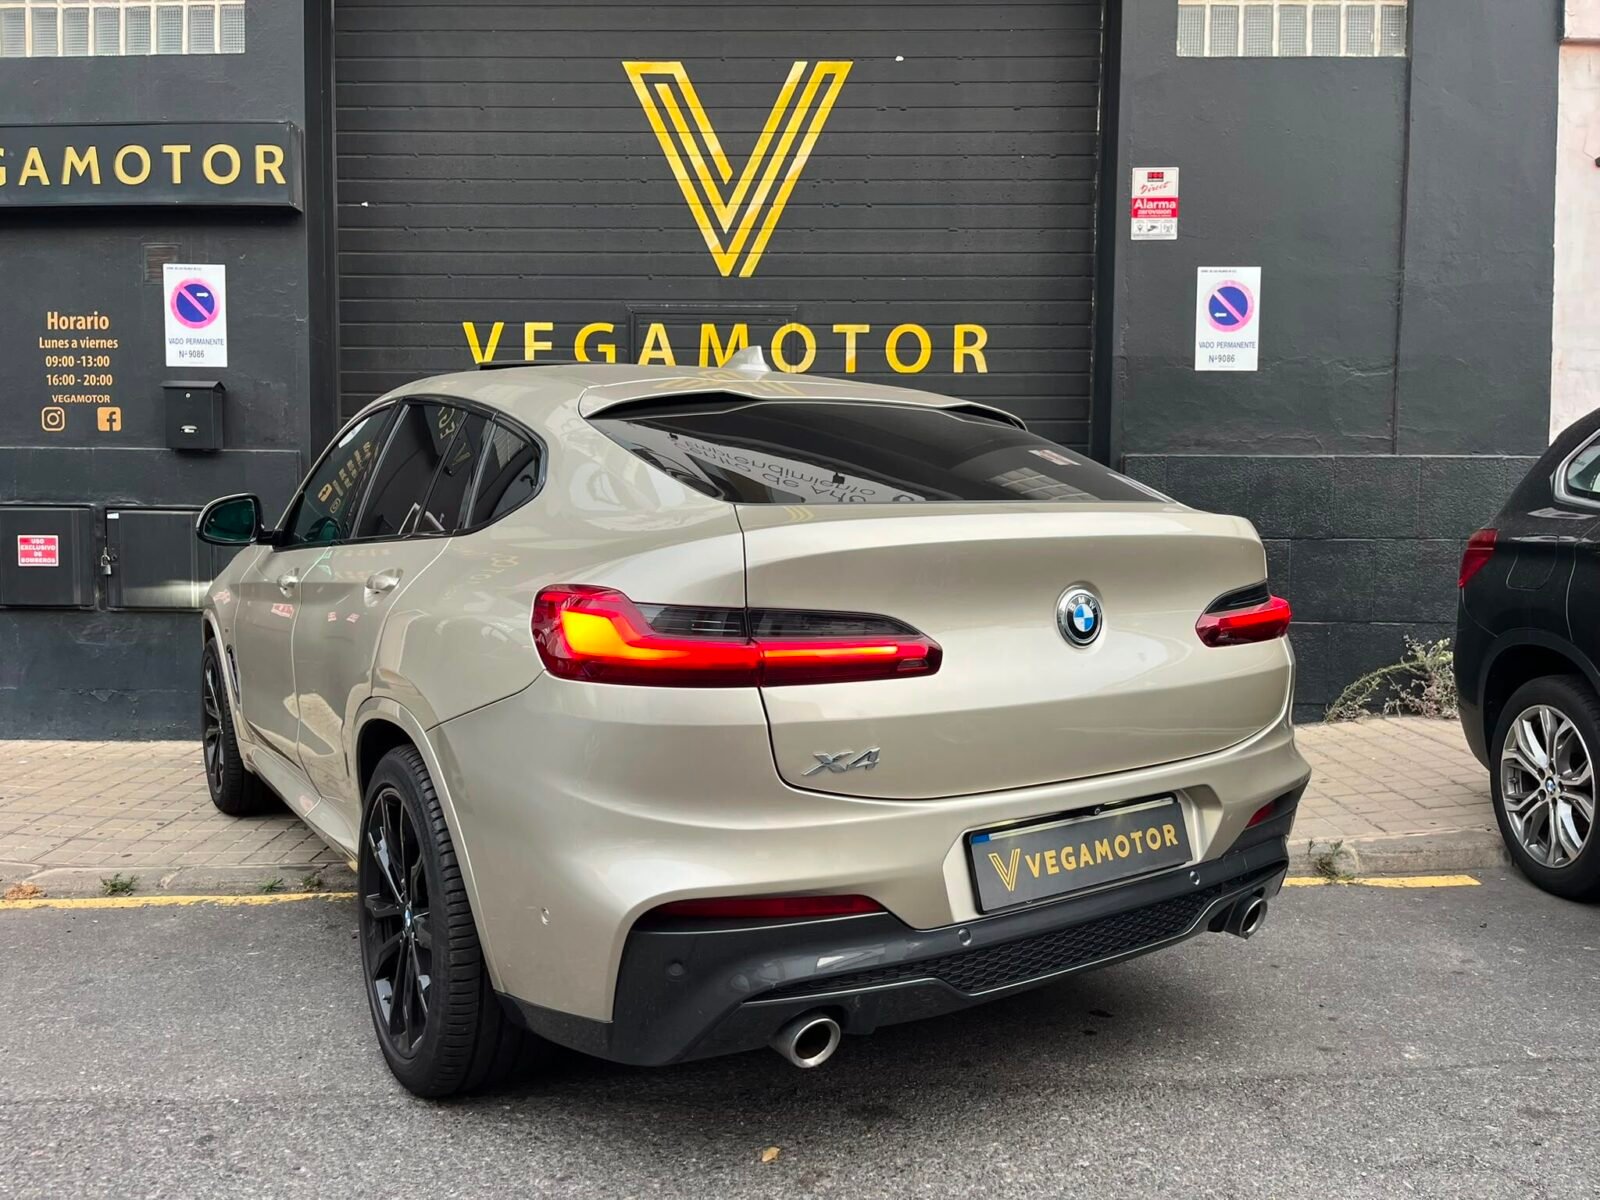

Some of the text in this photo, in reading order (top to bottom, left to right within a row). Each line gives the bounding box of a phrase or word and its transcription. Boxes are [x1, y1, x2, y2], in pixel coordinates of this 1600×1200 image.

[0, 143, 286, 186] AMOTOR
[1134, 198, 1177, 209] Alarma
[47, 311, 110, 331] Horario
[39, 337, 119, 349] Lunes a viernes
[185, 338, 225, 346] PERMANENTE
[462, 321, 988, 374] VEGAMOTOR
[1198, 341, 1256, 349] VADO PERMANENTE
[45, 355, 75, 367] 09:00
[46, 374, 75, 386] 16:00
[83, 374, 113, 386] 20:00
[52, 394, 110, 404] VEGAMOTOR
[1067, 595, 1097, 611] BMW
[800, 746, 881, 776] X4
[1025, 823, 1179, 879] VEGAMOTOR
